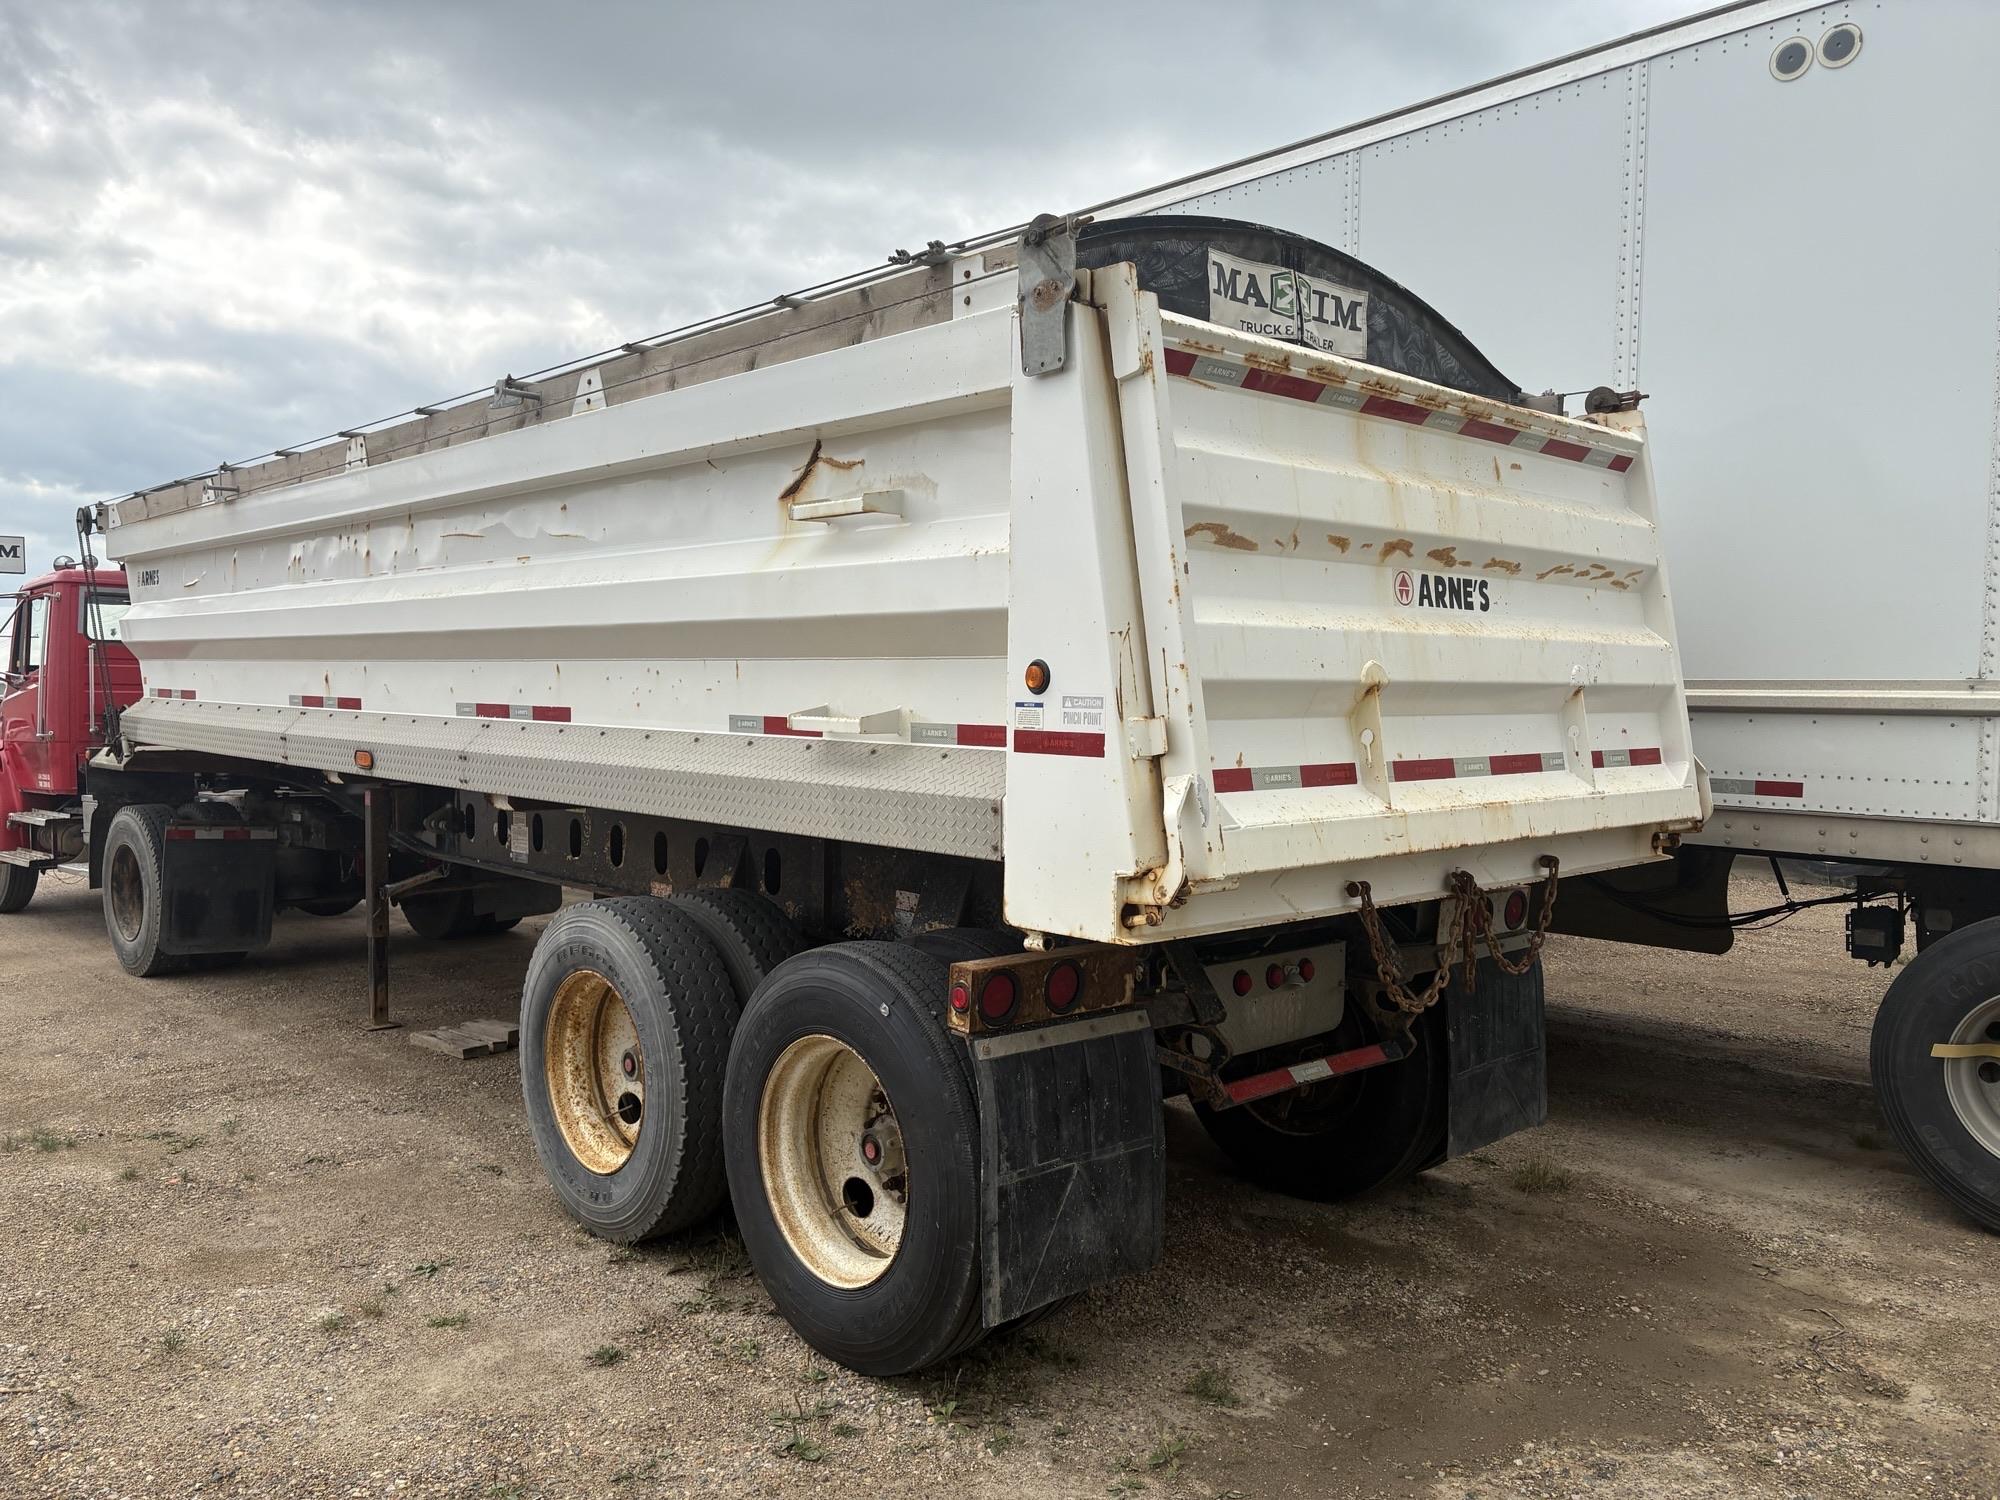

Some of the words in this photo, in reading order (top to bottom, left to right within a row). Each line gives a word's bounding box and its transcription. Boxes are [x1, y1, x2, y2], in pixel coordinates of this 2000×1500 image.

[1239, 319, 1282, 335] TRUCK
[1285, 325, 1294, 336] &
[1304, 328, 1334, 351] TRAILER
[1418, 573, 1490, 612] ARNE'S
[1074, 697, 1102, 708] CAUTION
[1063, 711, 1082, 725] PINCH
[1083, 712, 1103, 726] POINT
